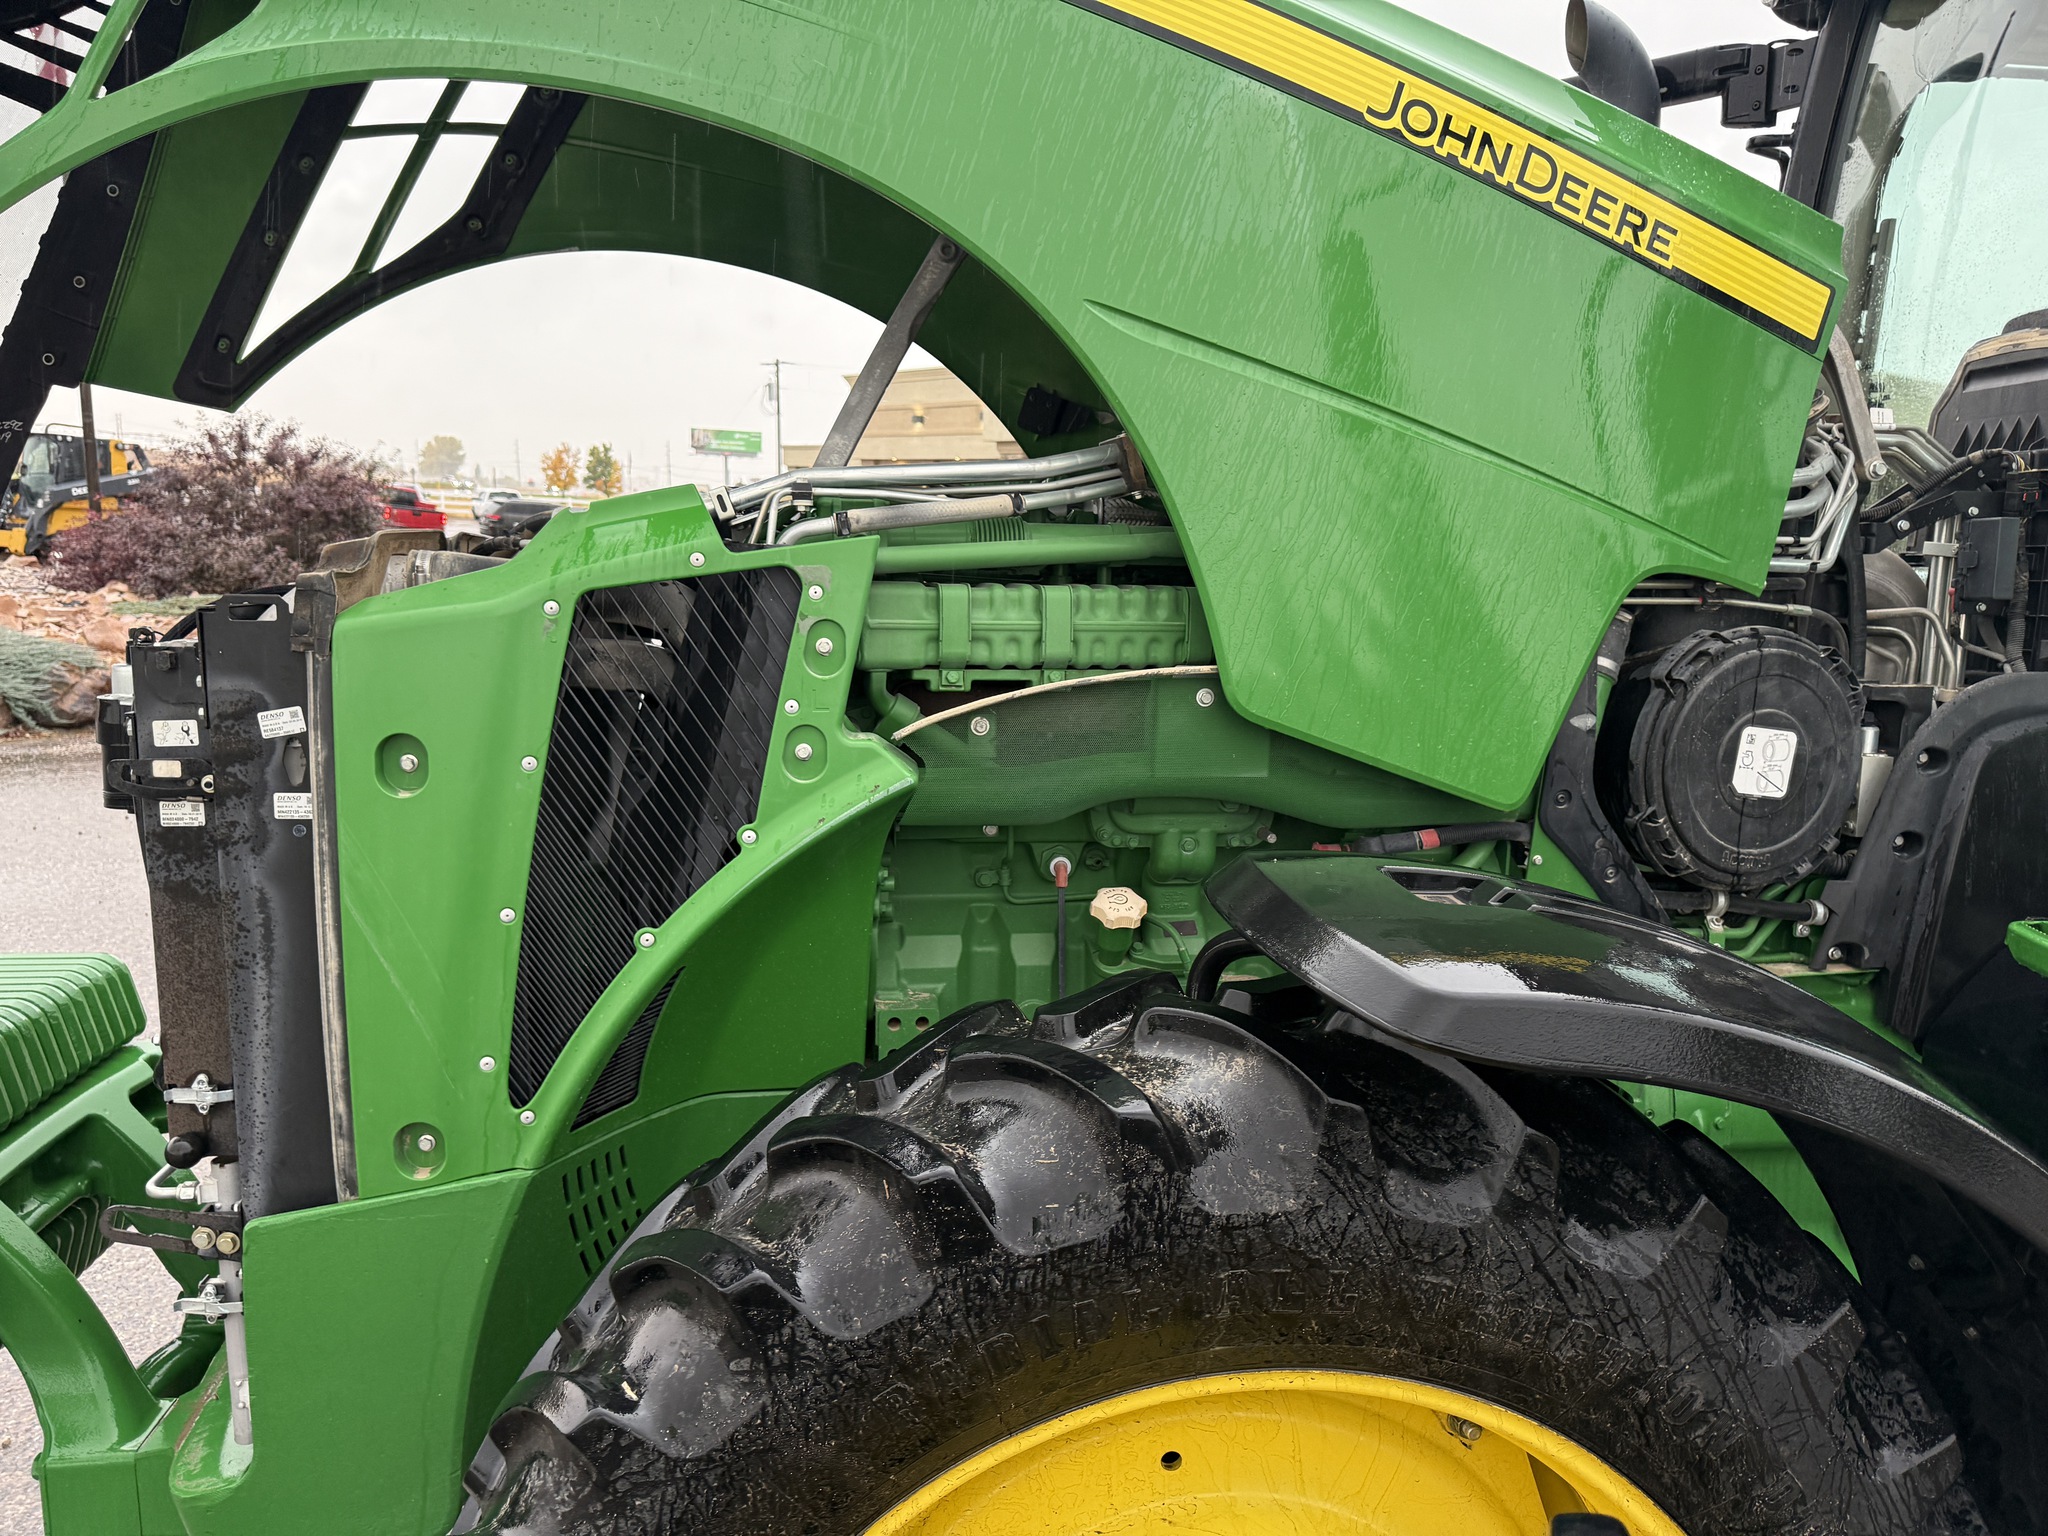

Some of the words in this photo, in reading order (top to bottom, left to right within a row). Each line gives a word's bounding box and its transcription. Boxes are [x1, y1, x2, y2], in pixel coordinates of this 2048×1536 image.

[1365, 80, 1514, 178] JOHN
[1515, 143, 1679, 261] DEERE
[71, 486, 89, 496] DEE
[260, 711, 285, 721] DENSO
[1216, 1268, 1360, 1318] ALL
